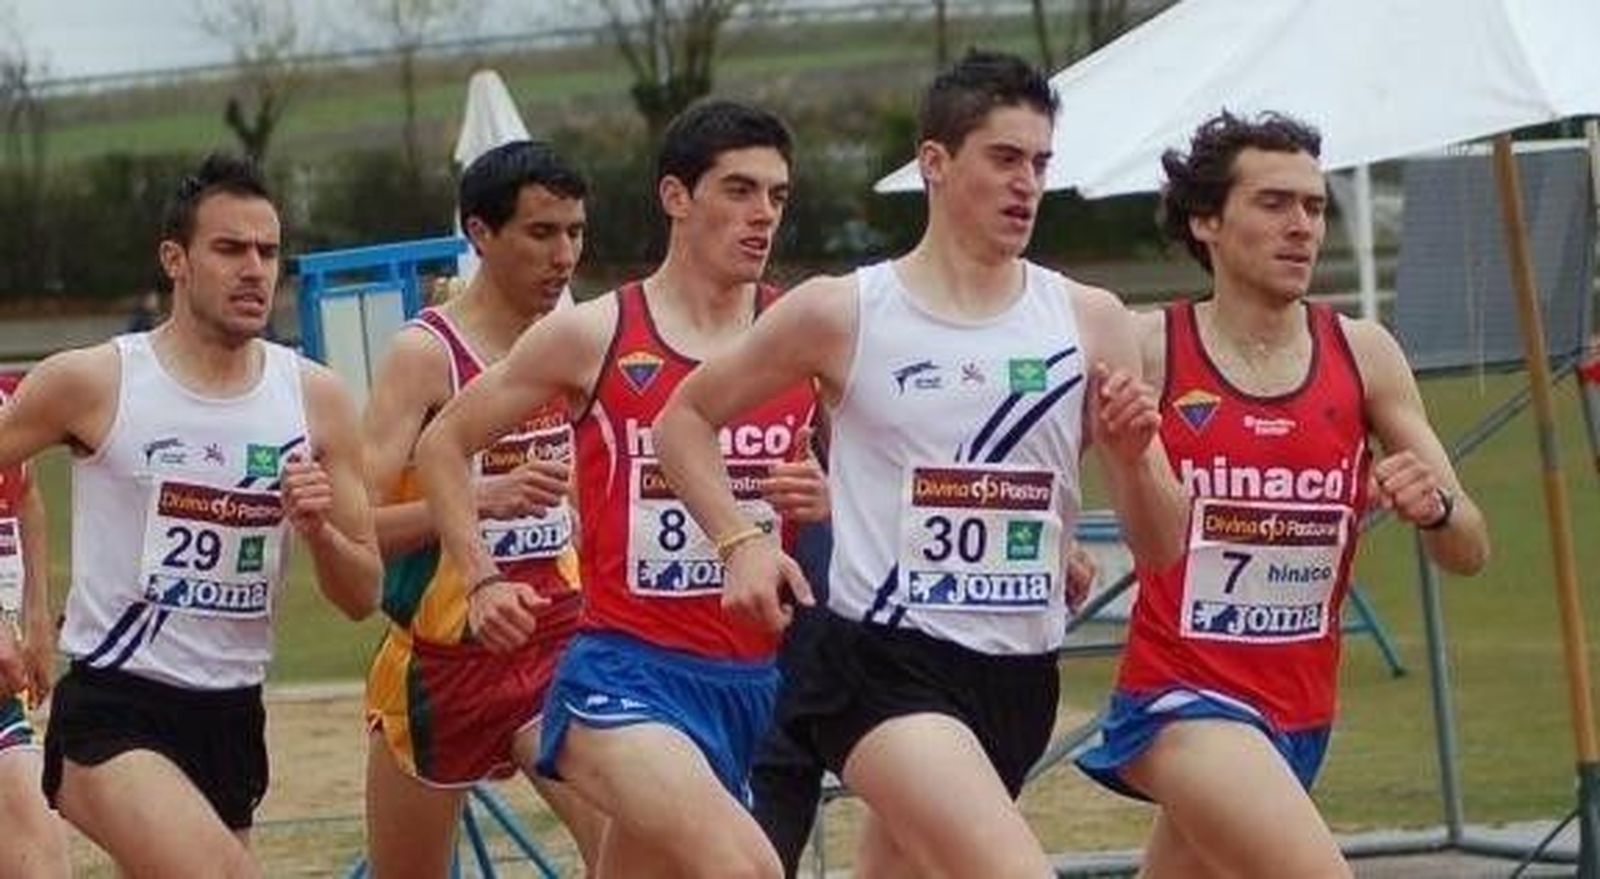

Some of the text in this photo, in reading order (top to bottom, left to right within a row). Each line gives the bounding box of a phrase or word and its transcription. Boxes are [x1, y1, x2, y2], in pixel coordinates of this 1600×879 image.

[917, 479, 969, 498] Divina
[1180, 455, 1345, 499] hinaco
[163, 490, 209, 513] Divina
[658, 508, 687, 551] 8
[922, 515, 988, 563] 30
[1205, 515, 1258, 535] Divina
[162, 526, 222, 571] 29
[1222, 551, 1333, 594] 7 hinaco
